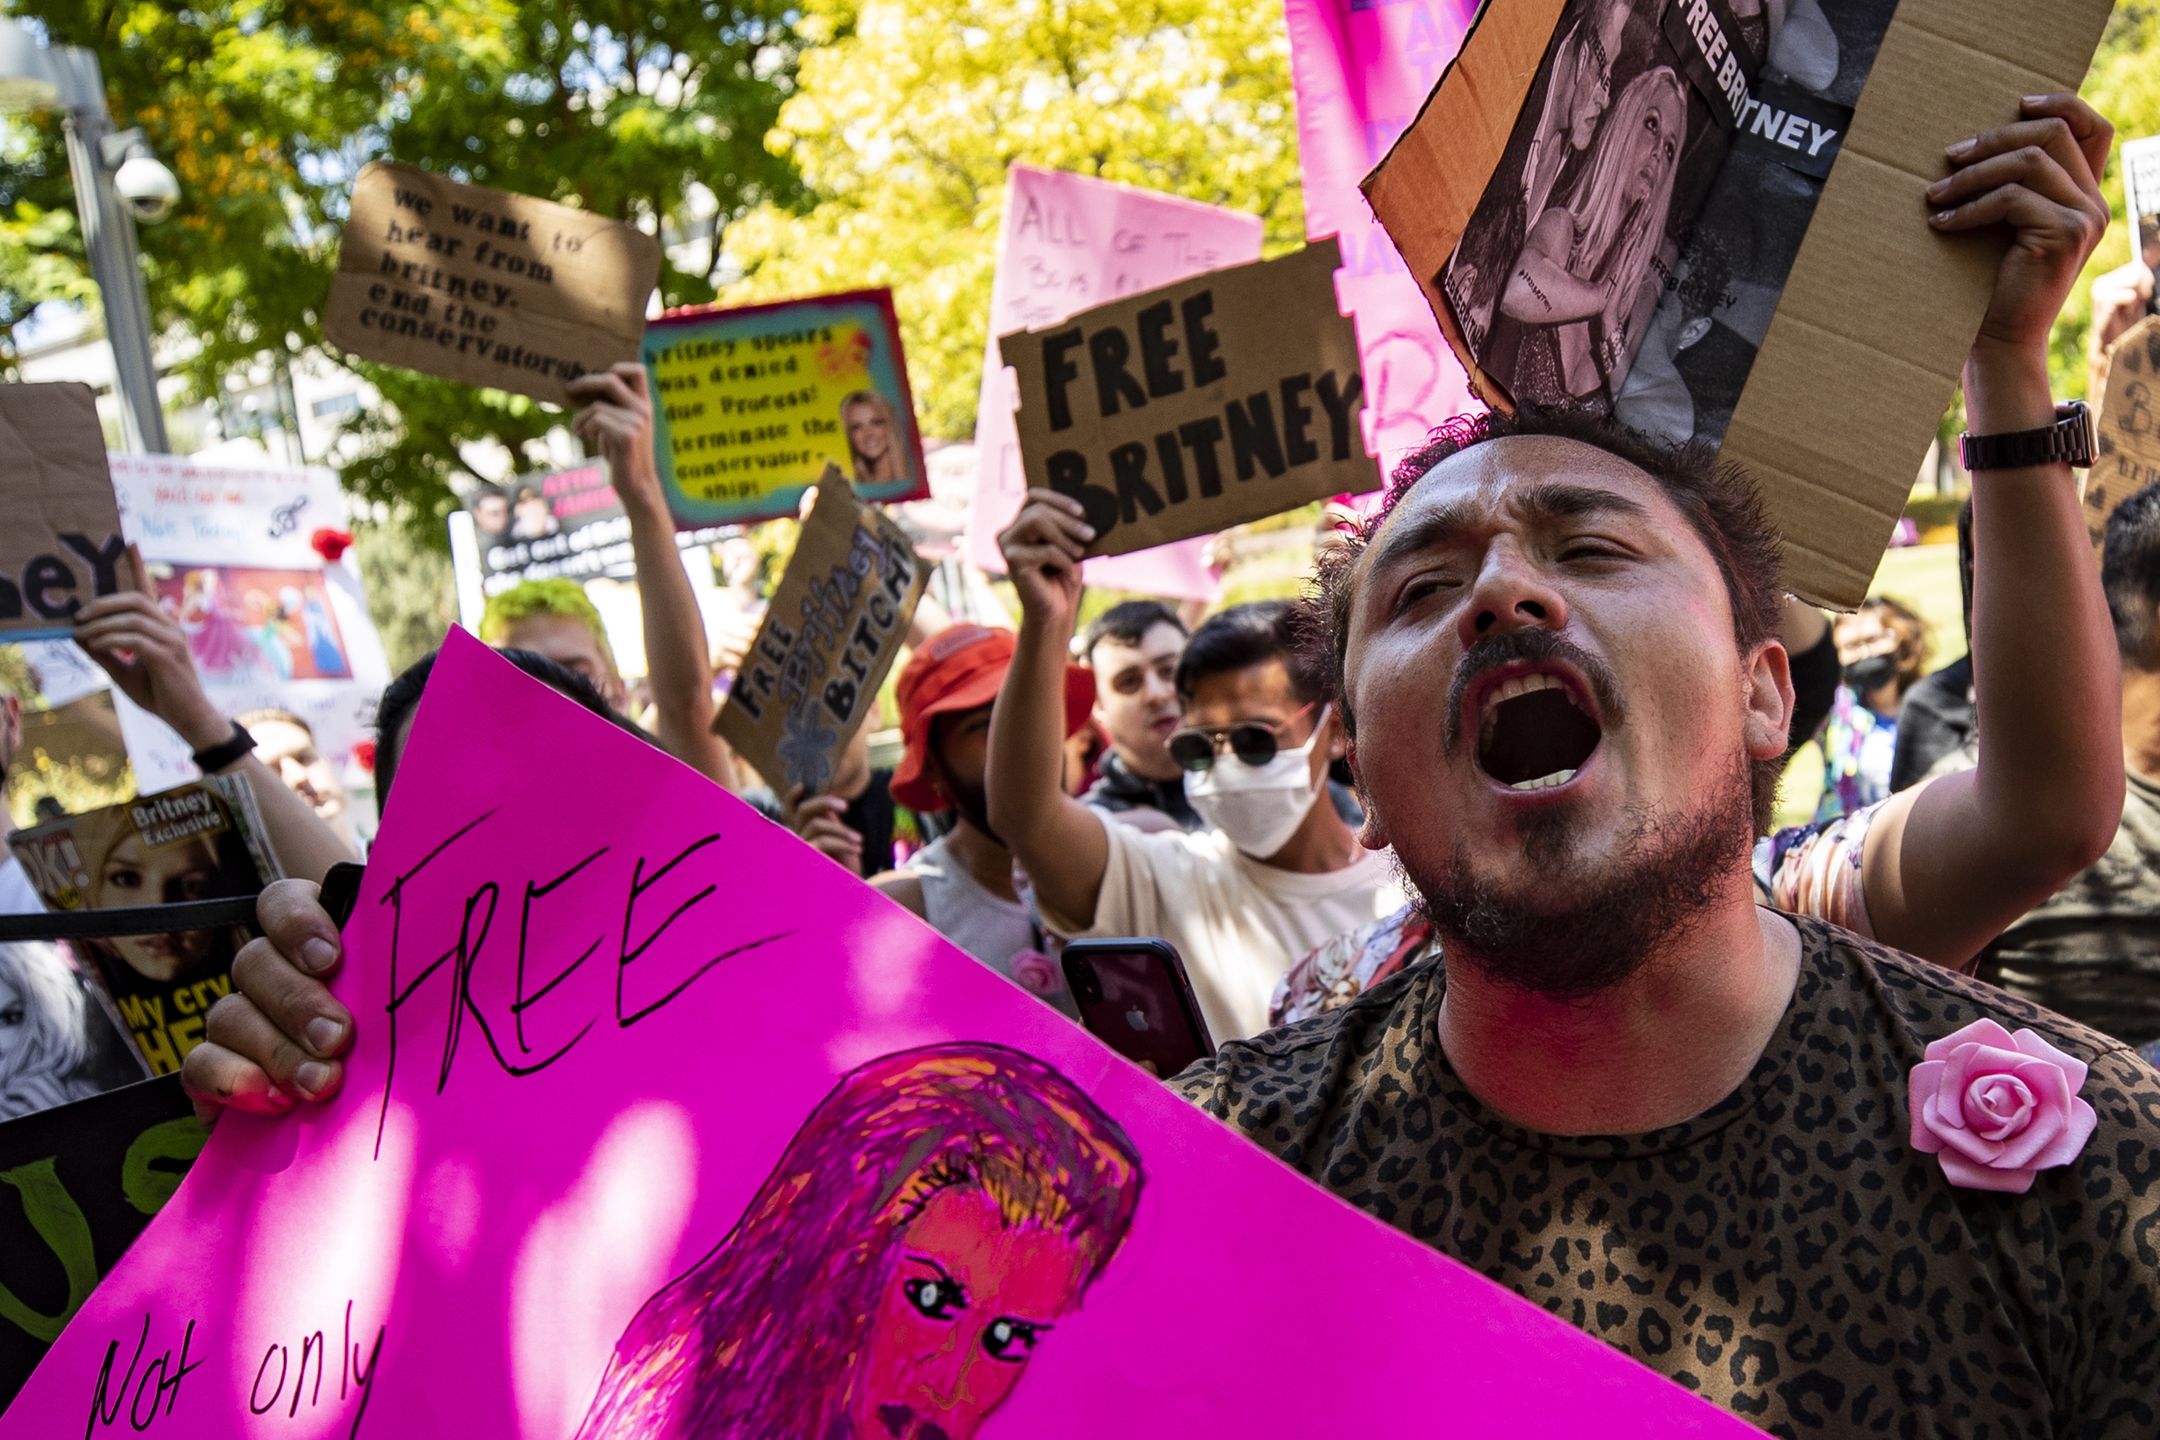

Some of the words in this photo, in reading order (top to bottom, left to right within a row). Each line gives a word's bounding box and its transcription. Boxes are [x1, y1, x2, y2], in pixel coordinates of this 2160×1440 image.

[386, 220, 462, 258] hear
[475, 242, 554, 284] from
[451, 204, 530, 241] want
[552, 230, 584, 253] to
[368, 283, 429, 315] end
[445, 303, 497, 334] the
[659, 374, 698, 393] was
[710, 356, 798, 383] denied
[1042, 290, 1227, 432] FREE
[672, 423, 790, 454] terminate
[802, 418, 838, 438] the
[1046, 370, 1363, 540] BRITNEY
[824, 535, 912, 724] BITCH
[731, 619, 794, 719] FREE
[131, 791, 212, 827] Britney
[141, 811, 221, 847] Exclusive
[375, 806, 797, 1161] FREE
[118, 994, 167, 1032] My
[85, 1312, 208, 1440] Not
[250, 1299, 385, 1440] only
